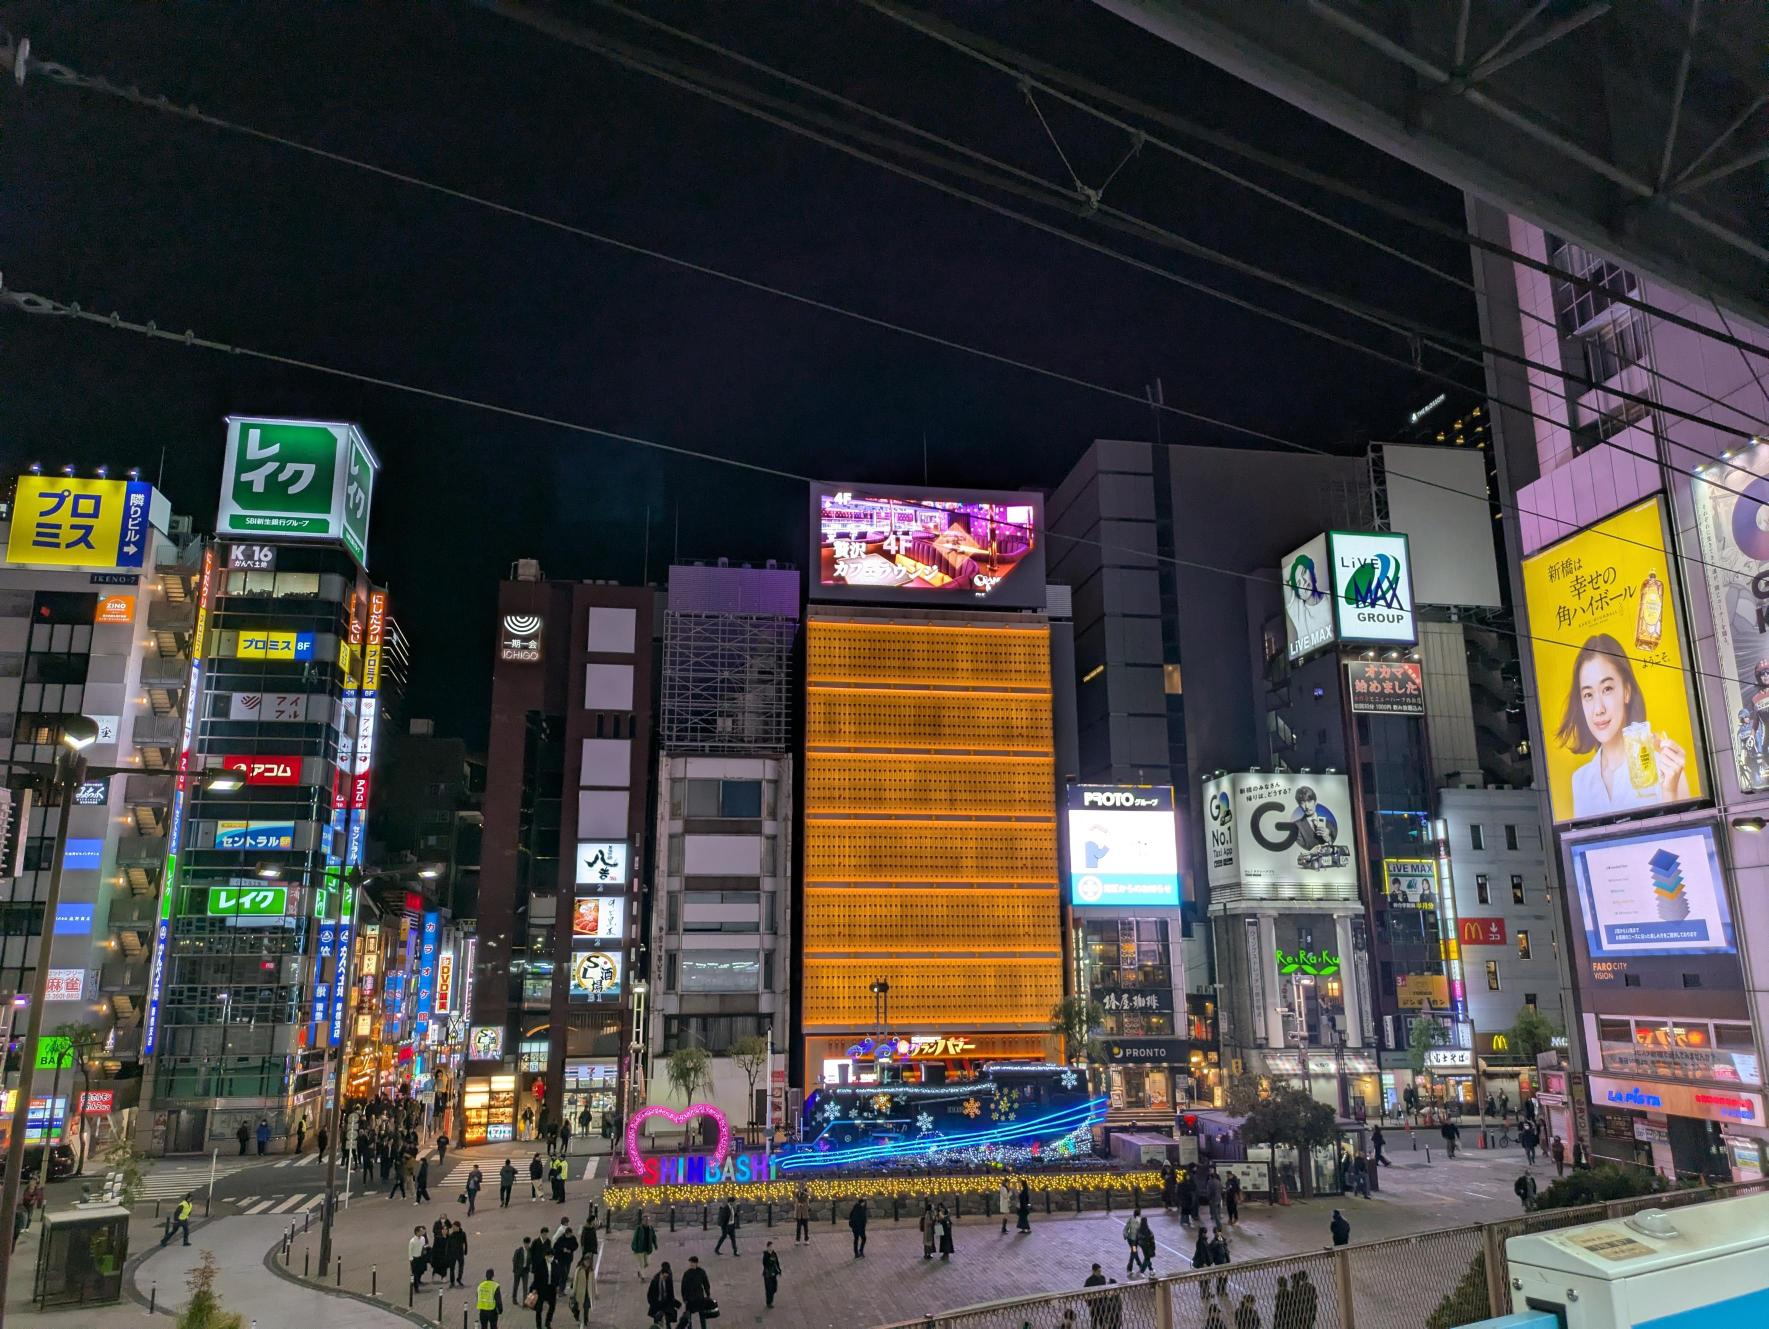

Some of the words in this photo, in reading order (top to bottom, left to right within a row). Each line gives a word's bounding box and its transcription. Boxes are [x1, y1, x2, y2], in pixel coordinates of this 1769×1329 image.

[38, 488, 102, 519] プロ
[32, 522, 96, 550] ミス
[1341, 556, 1380, 570] LiVE
[1547, 557, 1583, 583] 新橋は
[833, 562, 939, 580] カフェラウンジ
[1569, 566, 1617, 601] 幸せの
[1352, 576, 1404, 610] MAX
[1556, 585, 1638, 631] 角ハイボール
[1357, 612, 1404, 624] GROUP
[243, 639, 292, 651] プロミス
[297, 641, 311, 651] 8F
[503, 639, 538, 649] 一期一会
[1290, 637, 1312, 655] LiVE
[1312, 624, 1333, 646] MAX
[503, 650, 539, 660] ICHIGO
[1354, 679, 1419, 695] 始めました
[250, 763, 292, 777] アコム
[1083, 792, 1134, 807] PROTO
[222, 836, 279, 847] セントラル
[1212, 826, 1232, 847] No.1
[1223, 847, 1233, 857] App
[1411, 863, 1433, 873] MAX
[219, 891, 275, 909] レイク
[1593, 962, 1612, 971] FARO
[1613, 962, 1628, 970] CITY
[1593, 972, 1614, 980] VISION
[47, 976, 81, 993] 麻雀
[1126, 1048, 1167, 1057] PRONTO
[1433, 1053, 1466, 1063] 富士そば
[40, 1056, 63, 1065] BA
